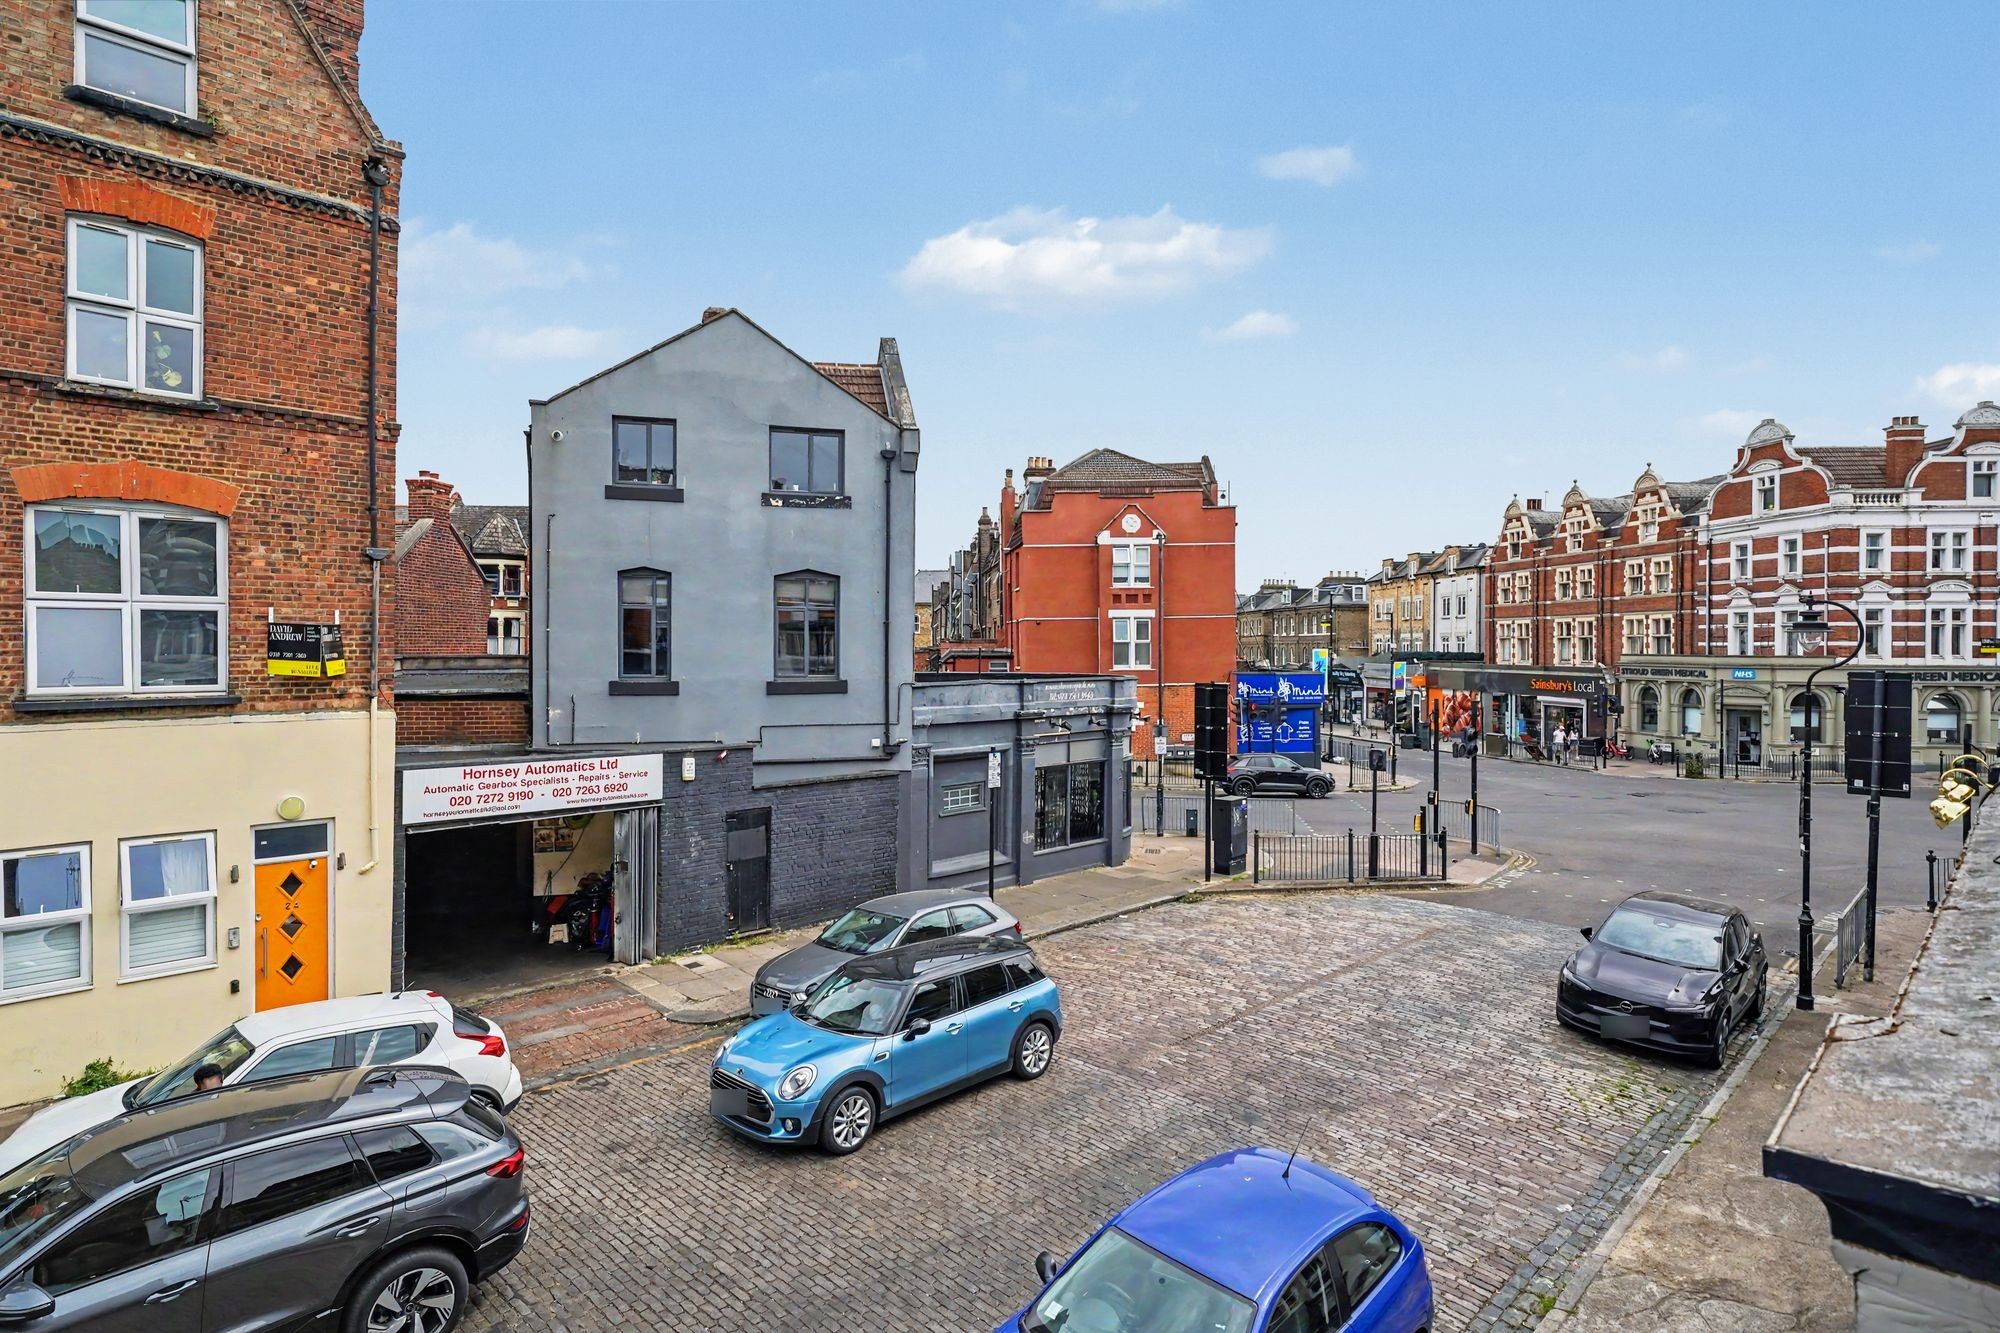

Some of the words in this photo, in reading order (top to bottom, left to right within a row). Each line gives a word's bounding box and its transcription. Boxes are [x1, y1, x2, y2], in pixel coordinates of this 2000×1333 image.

[269, 624, 293, 633] DAVID
[269, 632, 303, 641] ANDREW
[1621, 667, 1649, 676] STROUD
[1650, 668, 1673, 677] GREEN
[1674, 669, 1708, 678] MEDICAL
[1735, 670, 1753, 678] NHS
[1530, 678, 1572, 693] Sainsbury's
[1573, 680, 1595, 693] Local
[463, 767, 520, 781] Hornsey
[525, 761, 595, 776] Automatics
[599, 758, 619, 770] Ltd
[423, 783, 474, 795] Automatic
[478, 779, 518, 790] Gearbox
[520, 777, 569, 788] Specialists
[578, 773, 610, 784] Repairs
[619, 770, 648, 779] Service
[449, 796, 472, 807] 020
[476, 793, 504, 804] 7272
[508, 790, 534, 802] 9190
[552, 787, 572, 798] 020
[576, 785, 600, 796] 7263
[603, 782, 628, 793] 6920
